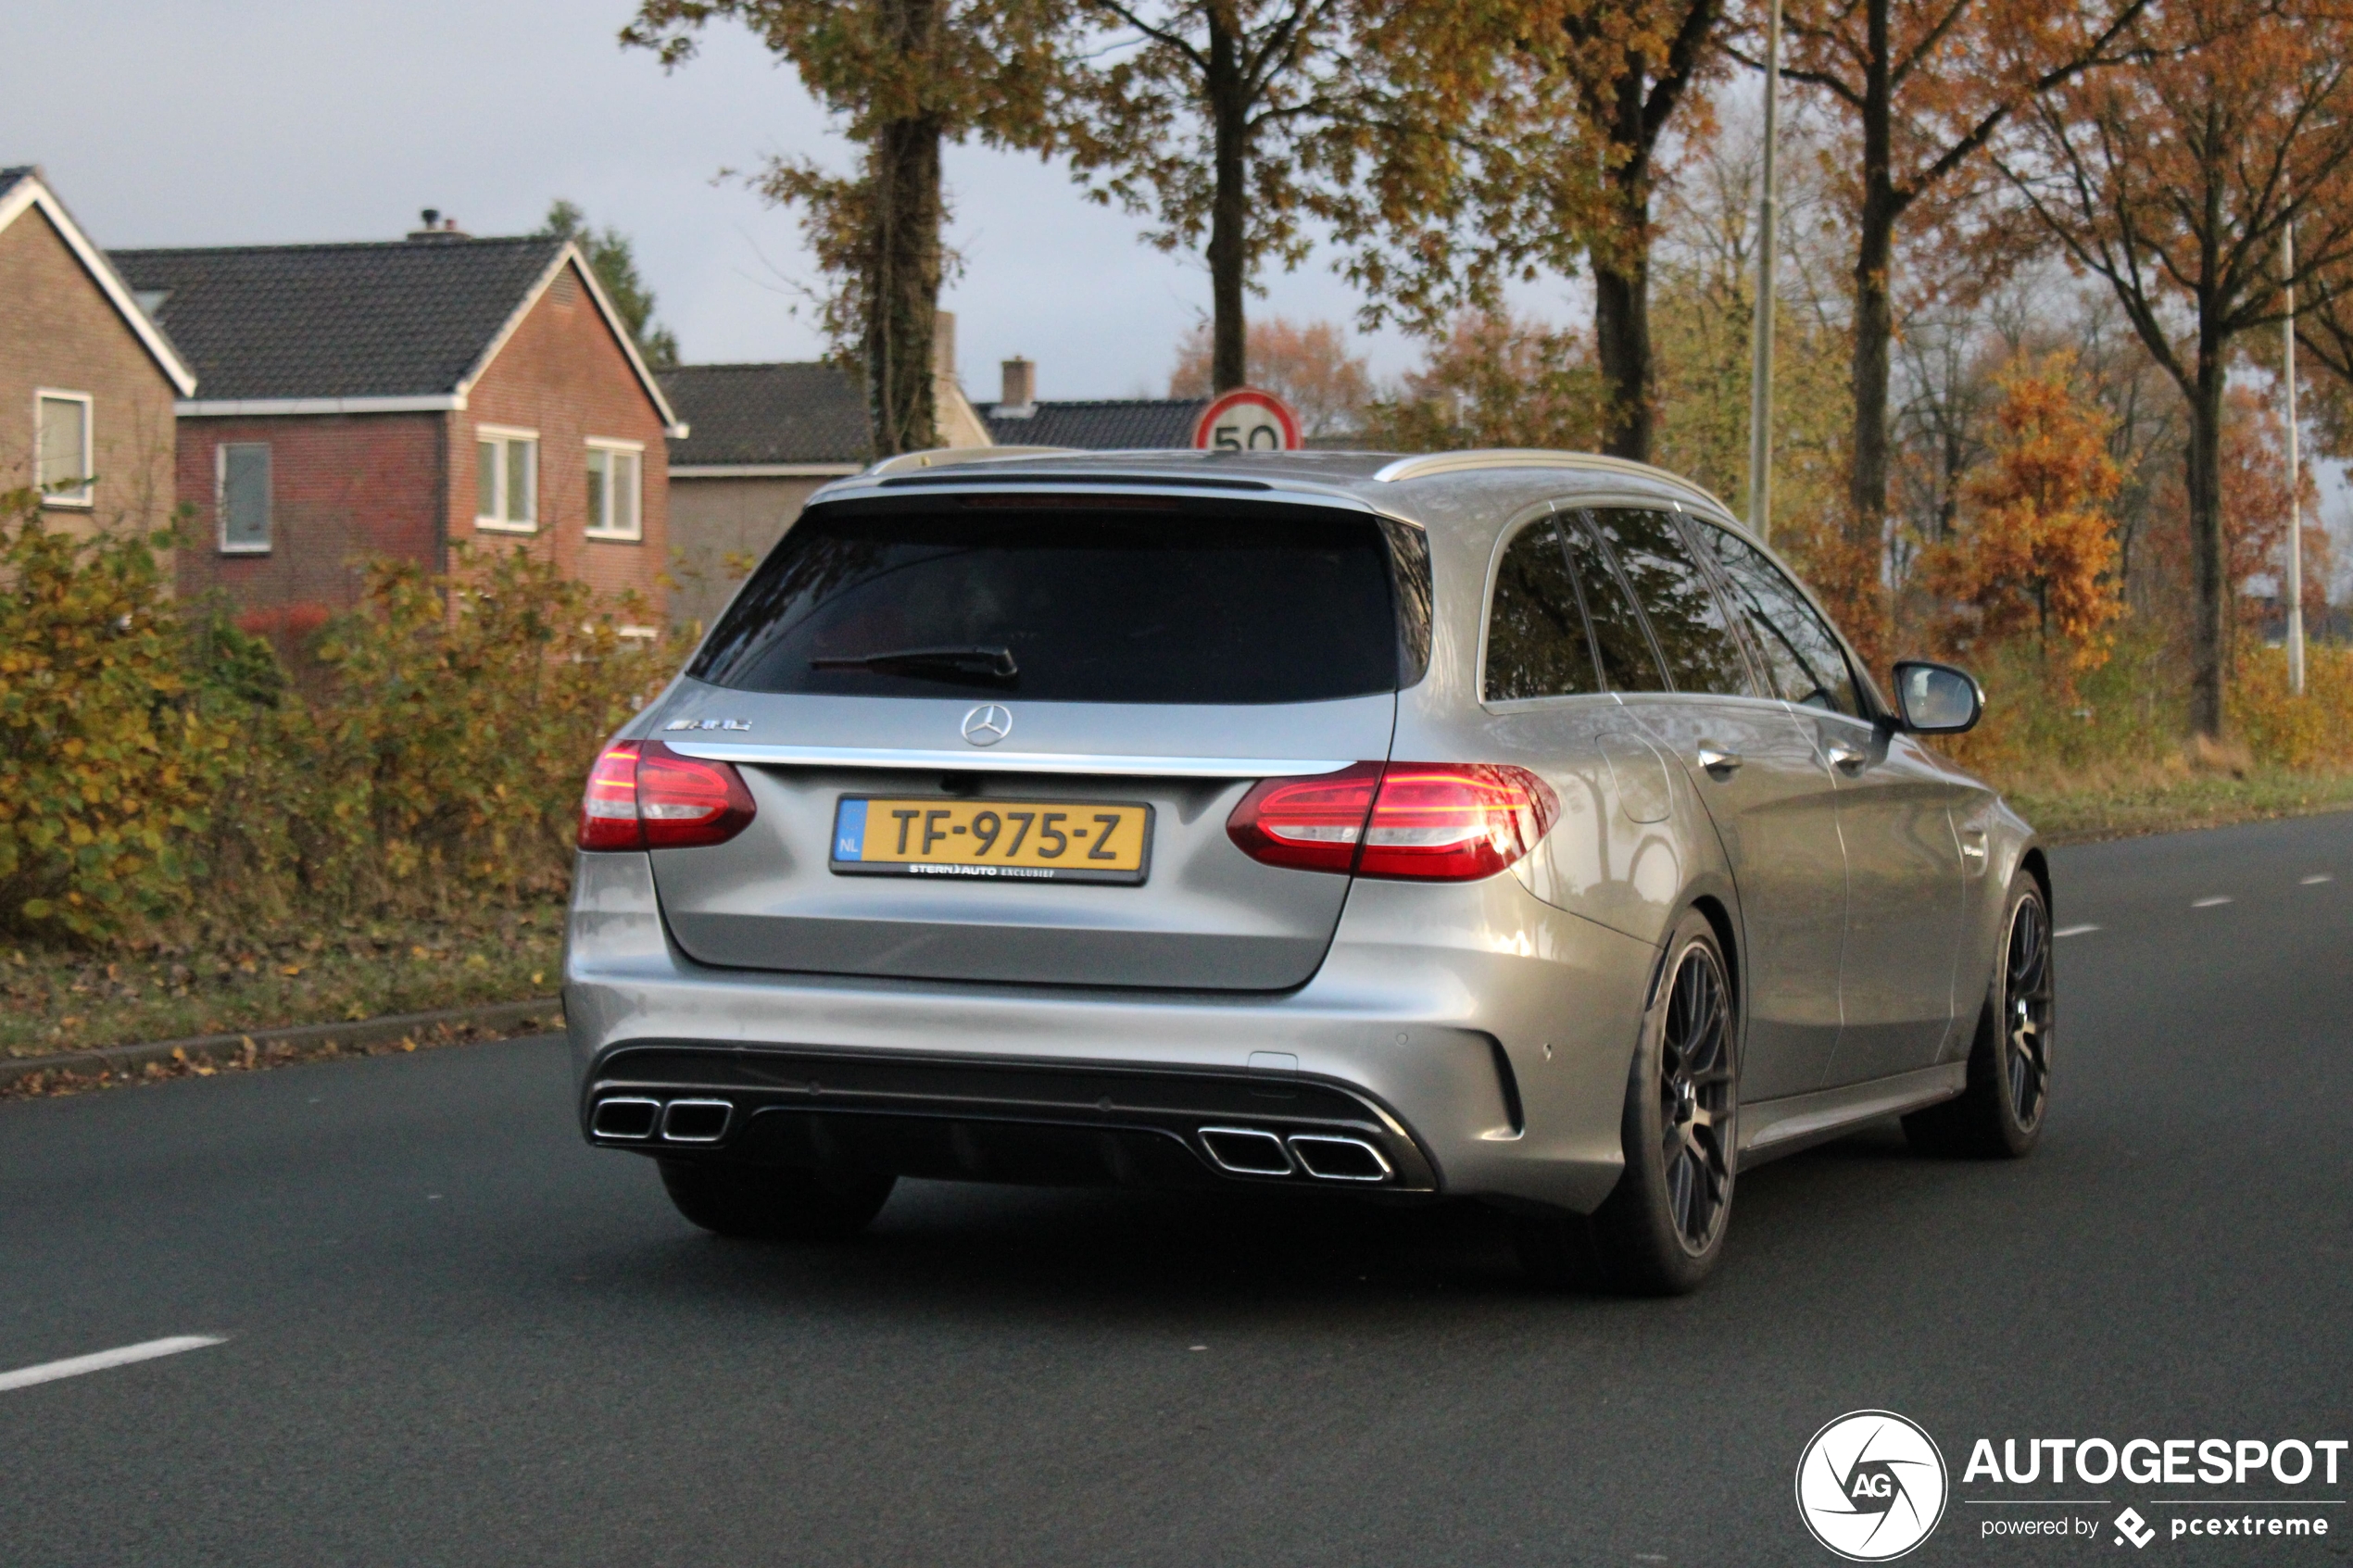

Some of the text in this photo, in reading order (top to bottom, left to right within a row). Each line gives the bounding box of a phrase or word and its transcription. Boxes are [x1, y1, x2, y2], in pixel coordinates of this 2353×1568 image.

[1215, 425, 1277, 451] 50
[839, 838, 859, 853] NL
[891, 810, 1122, 860] TF-975-Z
